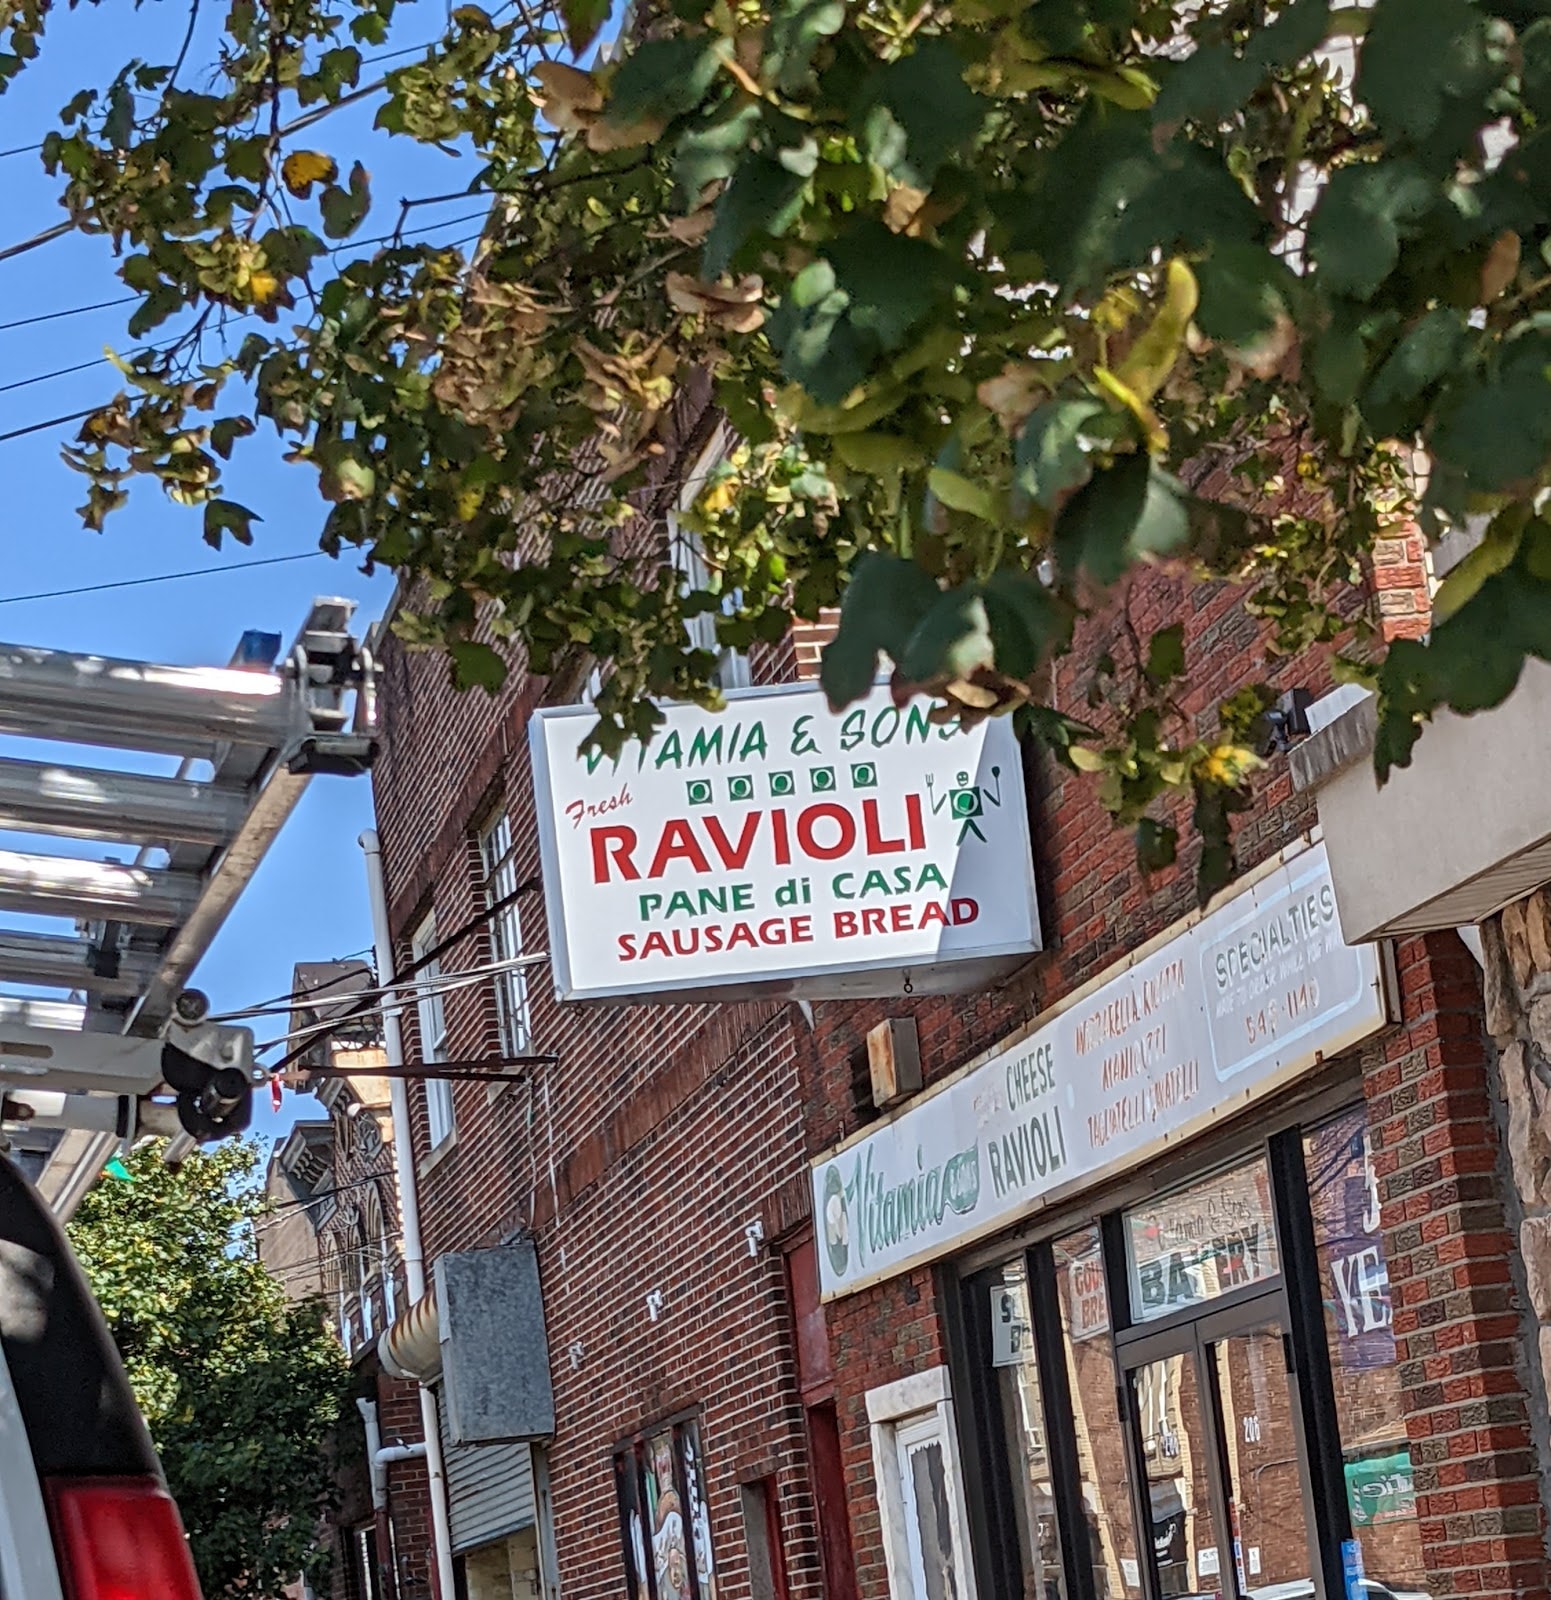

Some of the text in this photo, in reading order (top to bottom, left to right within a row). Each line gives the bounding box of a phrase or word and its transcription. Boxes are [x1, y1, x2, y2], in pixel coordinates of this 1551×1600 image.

[576, 720, 769, 776] VAMIA
[790, 714, 822, 755] &
[564, 782, 633, 829] Fresh
[589, 793, 927, 885] RAVIOLI
[637, 862, 949, 922] PANE di CASA
[617, 898, 979, 962] SAUSAGE BREAD
[1215, 884, 1334, 989] SPECIALTIES
[1006, 1043, 1056, 1111] CHEESE
[988, 1105, 1068, 1198] RAVIOLI
